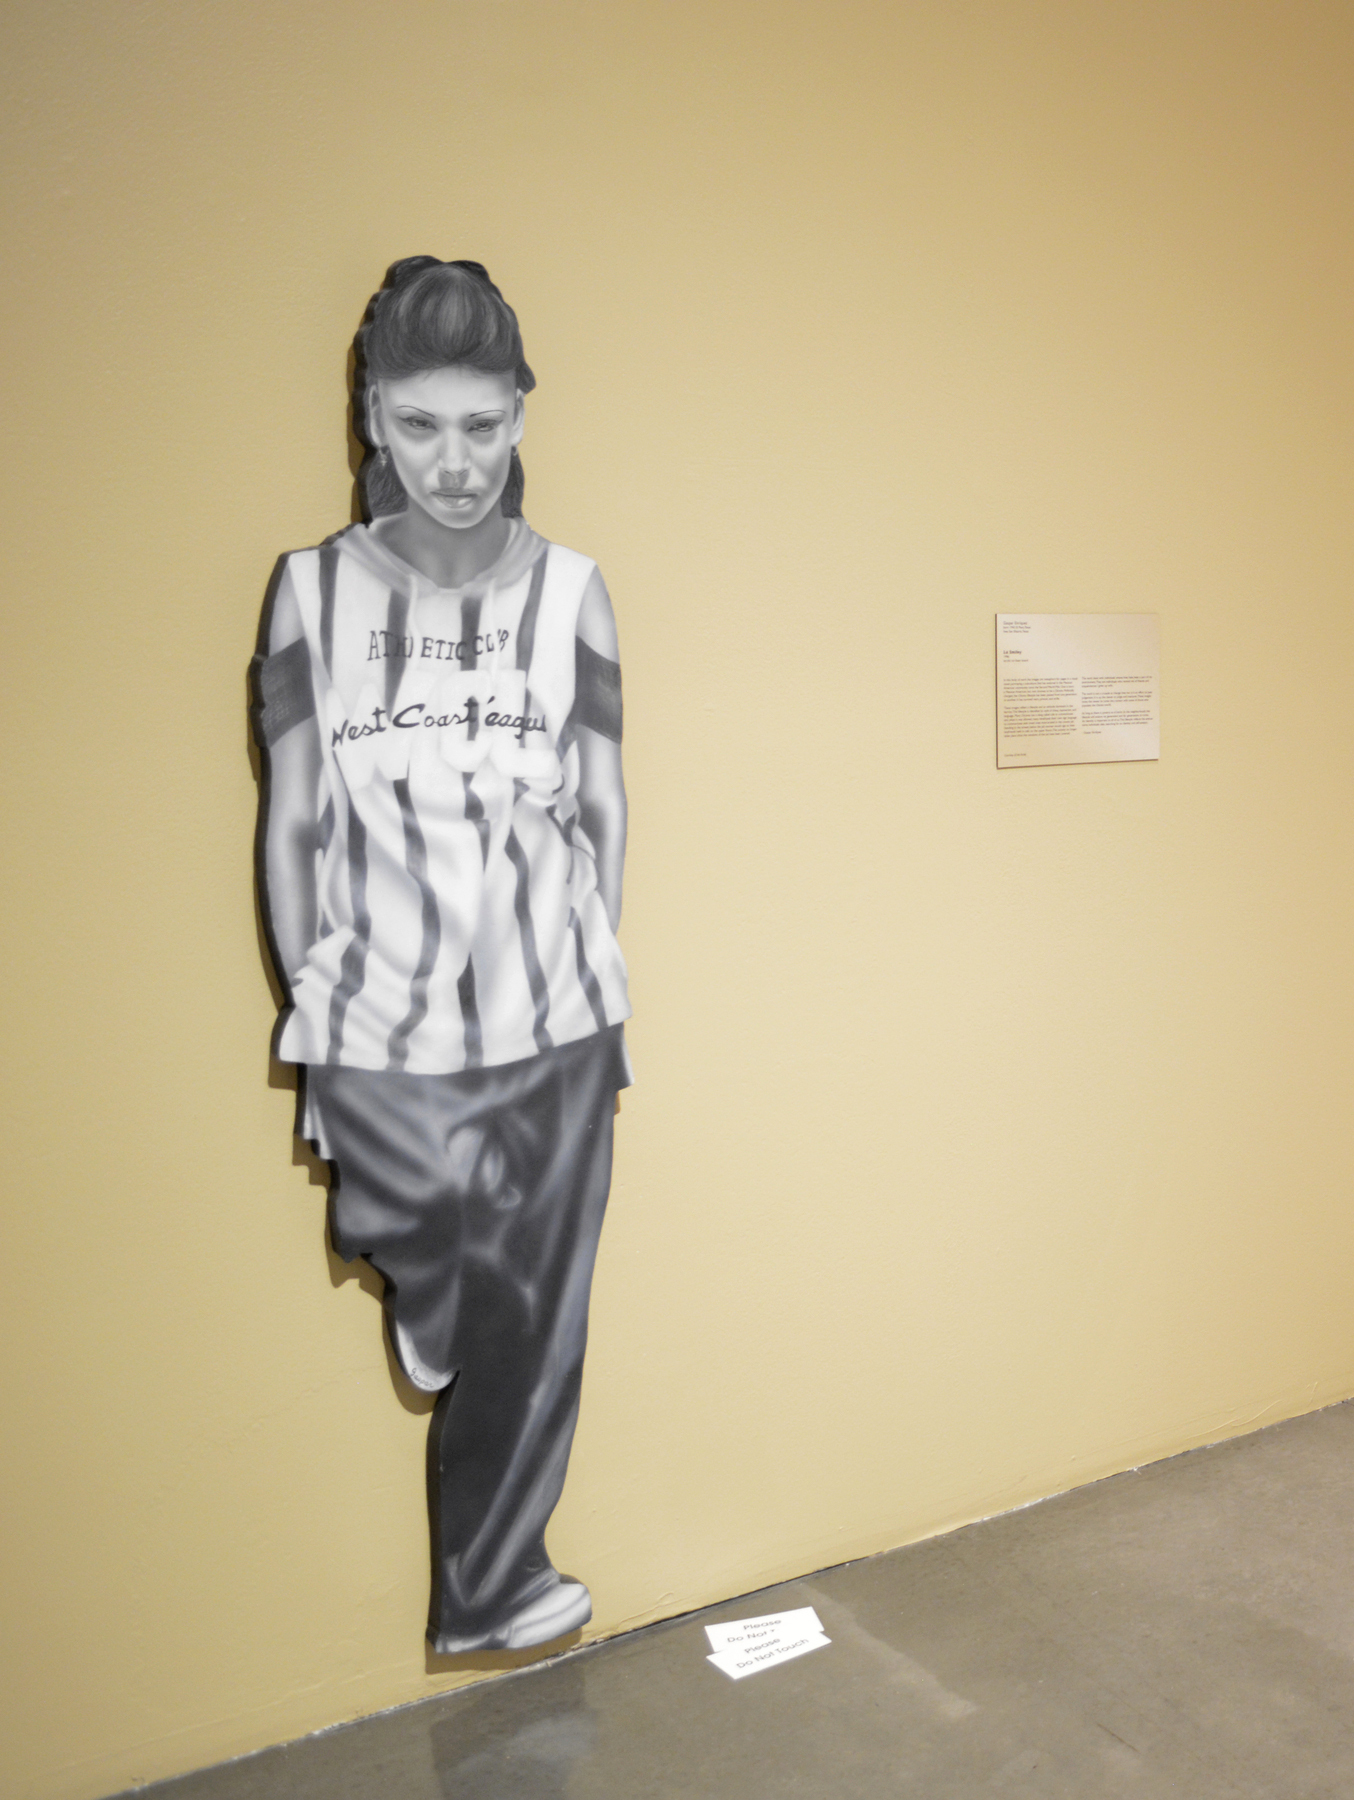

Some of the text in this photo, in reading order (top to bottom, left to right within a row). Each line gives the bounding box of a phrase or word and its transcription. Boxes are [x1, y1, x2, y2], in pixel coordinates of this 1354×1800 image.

[473, 629, 509, 655] CLB
[392, 696, 479, 729] Coast
[743, 1619, 782, 1631] Please
[747, 1631, 767, 1640] Not
[736, 1638, 809, 1669] Do Not Touch
[744, 1638, 781, 1654] Please
